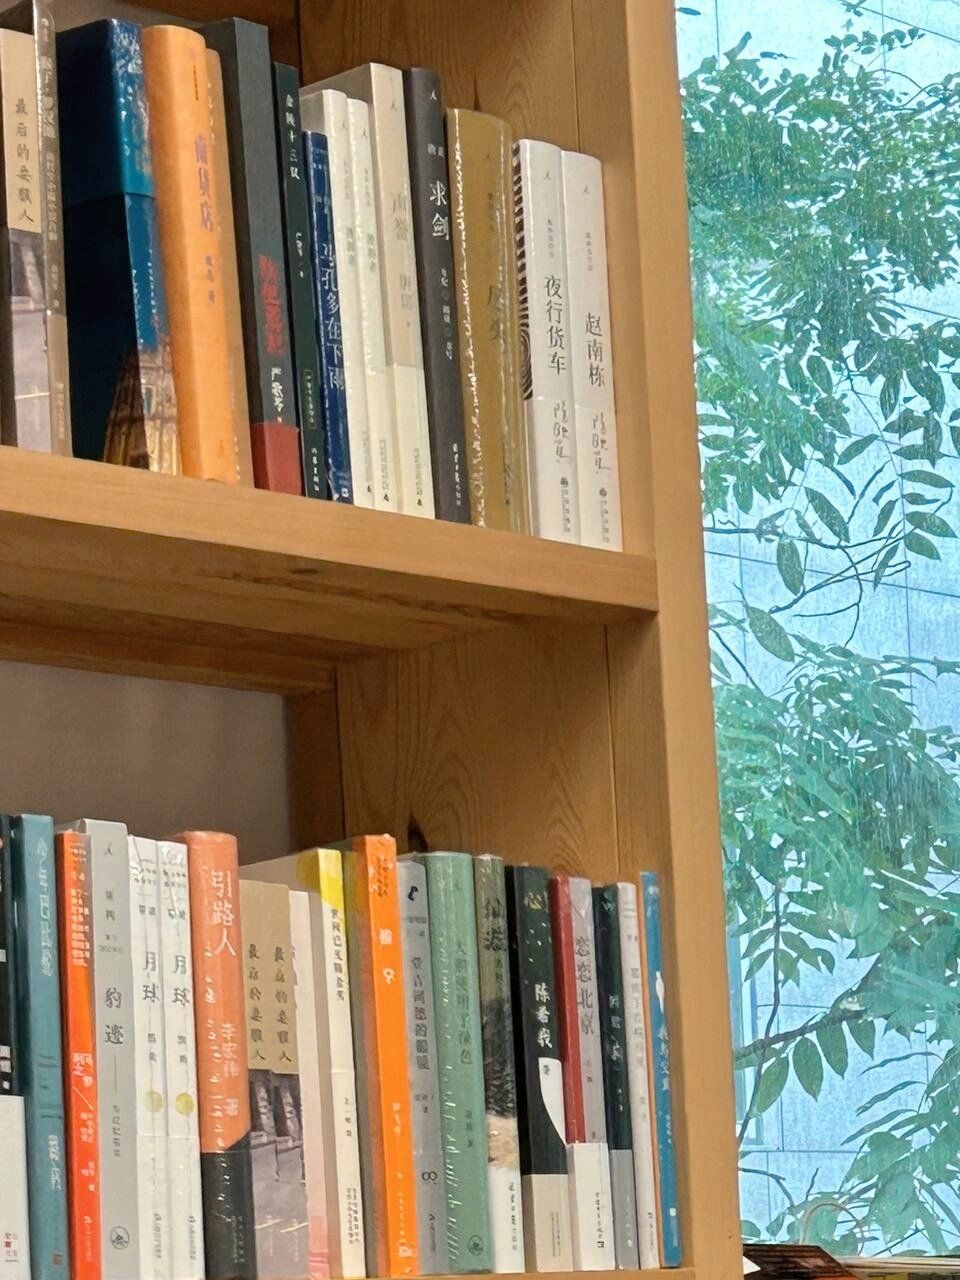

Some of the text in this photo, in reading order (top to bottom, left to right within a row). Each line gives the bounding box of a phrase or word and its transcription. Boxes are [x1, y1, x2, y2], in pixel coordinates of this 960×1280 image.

[429, 180, 450, 241] 求剑
[544, 274, 567, 377] 夜行货车
[584, 312, 606, 388] 赵南栋
[209, 868, 238, 958] 引路人
[142, 950, 161, 1003] 月球
[172, 955, 191, 1007] 月球
[103, 986, 125, 1046] 豹迹
